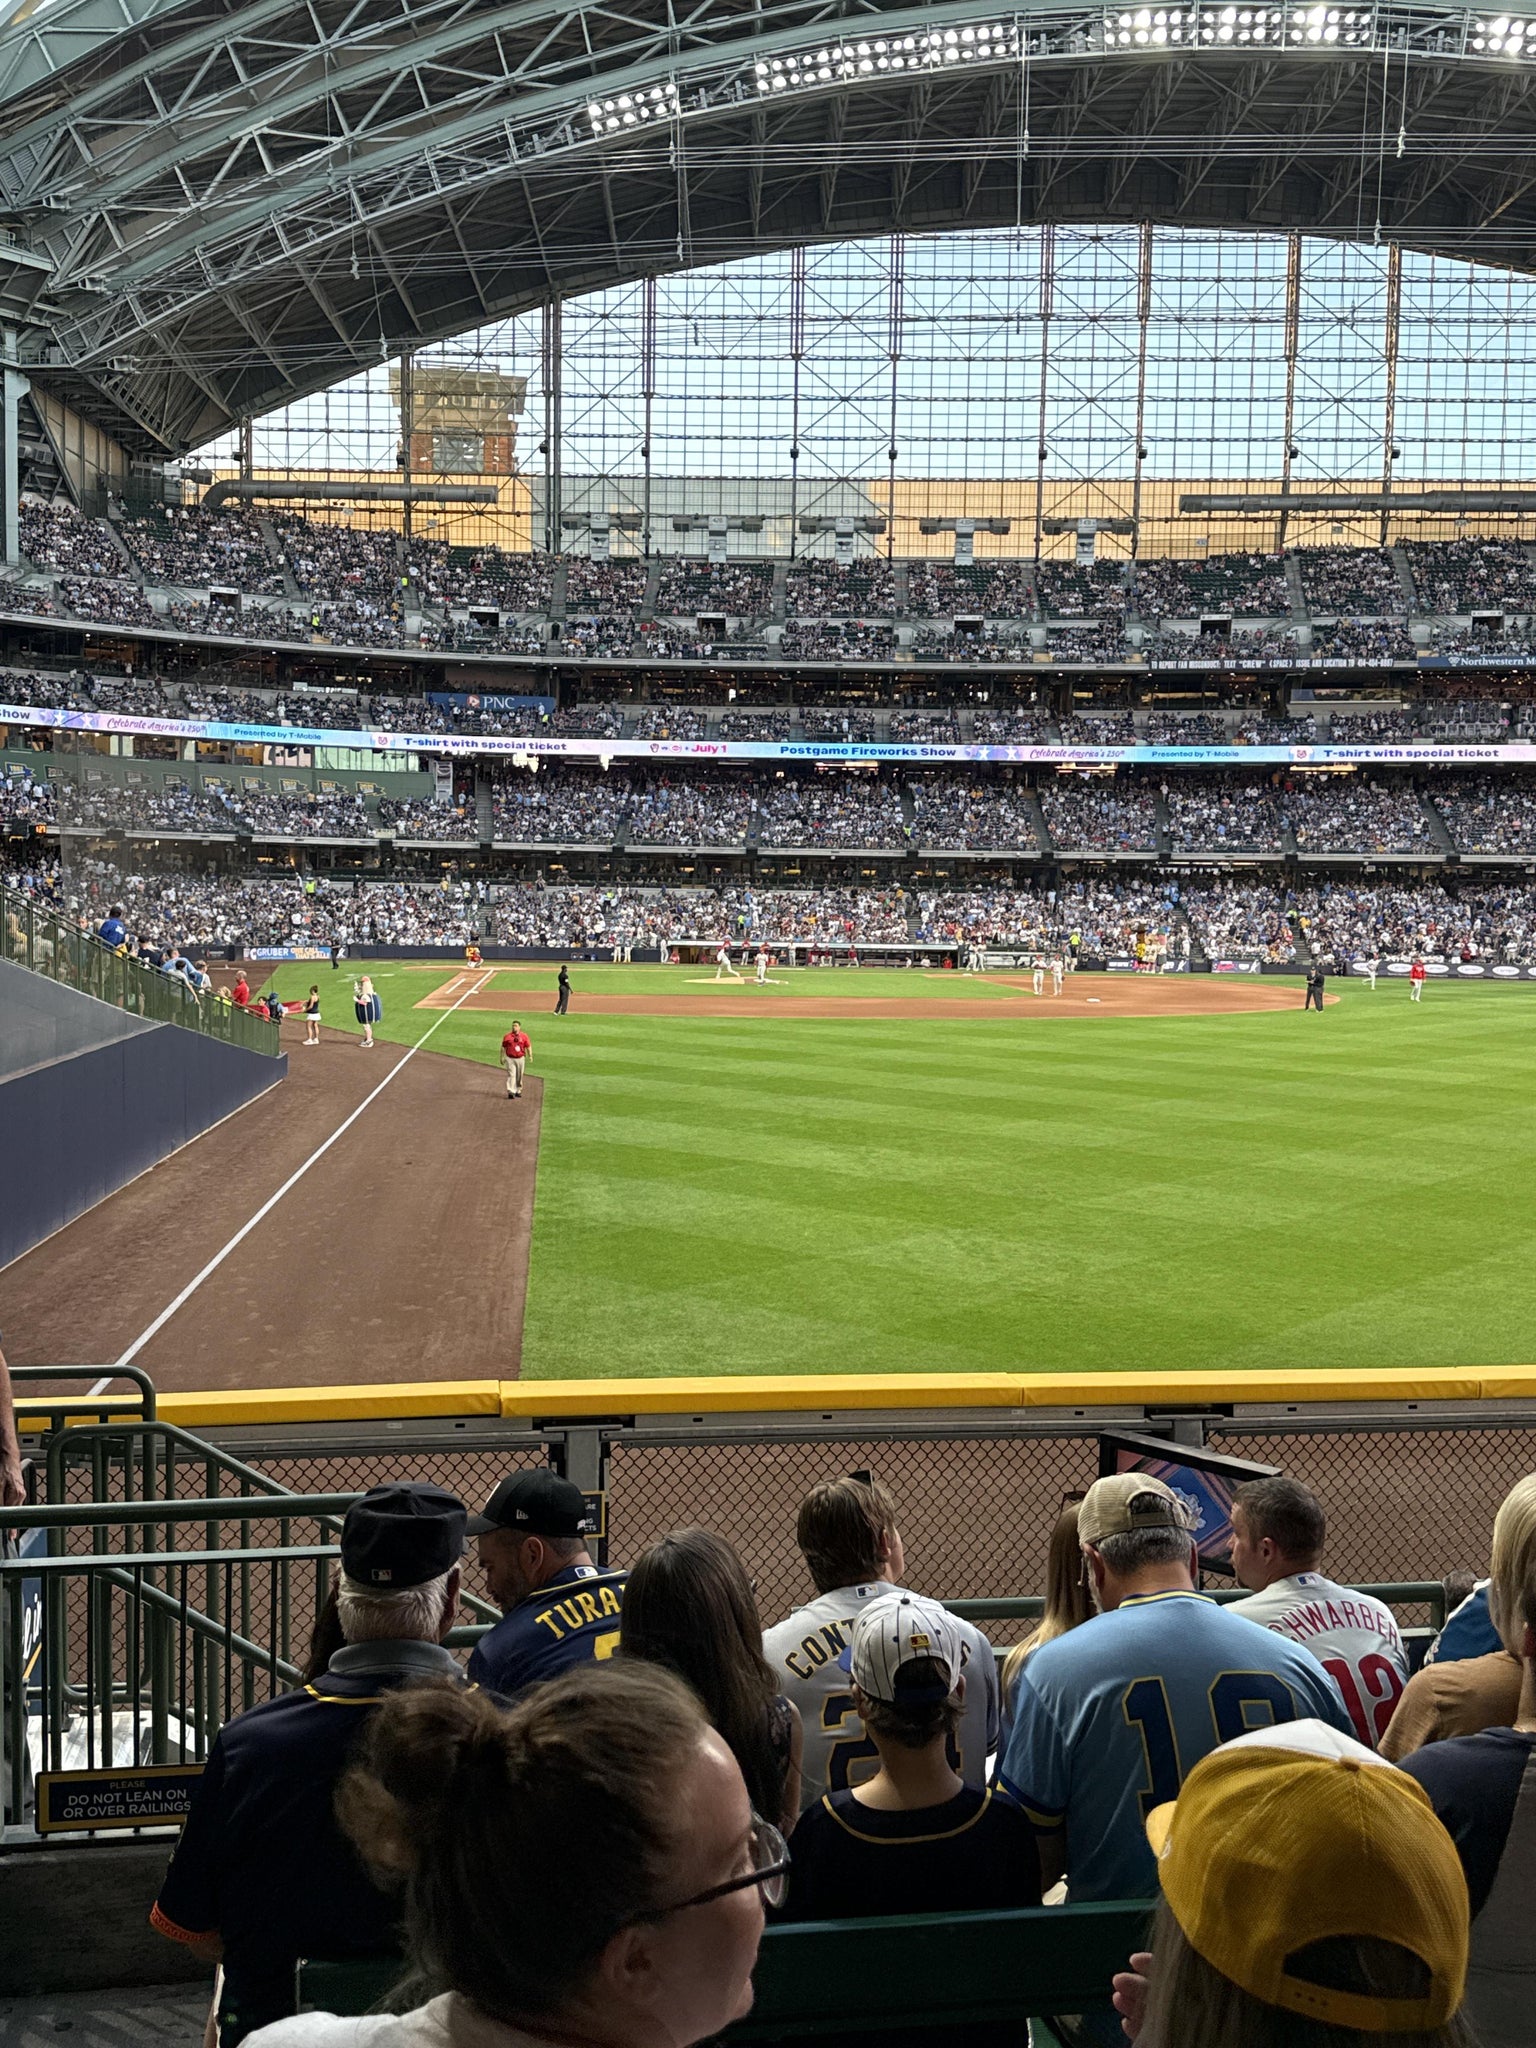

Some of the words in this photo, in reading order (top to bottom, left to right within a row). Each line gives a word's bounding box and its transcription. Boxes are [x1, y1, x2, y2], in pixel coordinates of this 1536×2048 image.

[1159, 660, 1177, 669] REPORT
[1178, 660, 1188, 669] FAN
[1224, 660, 1236, 669] TEXT
[1295, 659, 1310, 668] ISSUE
[1312, 659, 1322, 668] AND
[1323, 659, 1347, 668] LOCATION
[1461, 656, 1524, 666] Northwestern
[1526, 656, 1536, 666] M
[483, 696, 516, 709] PNC
[0, 708, 30, 720] how
[107, 717, 147, 730] Celebrate
[234, 728, 276, 738] Presented
[277, 729, 287, 739] by
[289, 731, 322, 740] T-Mobile
[404, 737, 449, 748] T-shirt
[450, 738, 479, 748] with
[481, 739, 527, 751] special
[529, 740, 567, 751] ticket
[691, 744, 719, 755] July
[721, 744, 727, 753] 1
[780, 745, 848, 757] Postgame
[851, 746, 917, 756] Fireworks
[920, 746, 956, 757] Show
[1030, 747, 1067, 759] Celebrate
[1068, 748, 1106, 759] America's
[1152, 750, 1193, 758] Presented
[1194, 750, 1204, 759] by
[1206, 750, 1239, 758] T-Mobile
[1324, 749, 1371, 758] T-shirt
[1373, 749, 1404, 758] with
[1406, 749, 1455, 759] special
[1457, 749, 1499, 758] ticket
[257, 947, 289, 957] GRUBER
[534, 1584, 626, 1640] TURA
[1268, 1600, 1398, 1650] HWARBER
[1320, 1652, 1405, 1750] 12
[110, 1780, 146, 1790] PLEASE
[68, 1795, 89, 1806] DO
[93, 1792, 122, 1804] NOT
[126, 1790, 162, 1802] LEAN
[166, 1789, 187, 1800] ON
[63, 1807, 83, 1819] OR
[87, 1804, 125, 1817] OVER
[129, 1801, 191, 1815] RAILINGS
